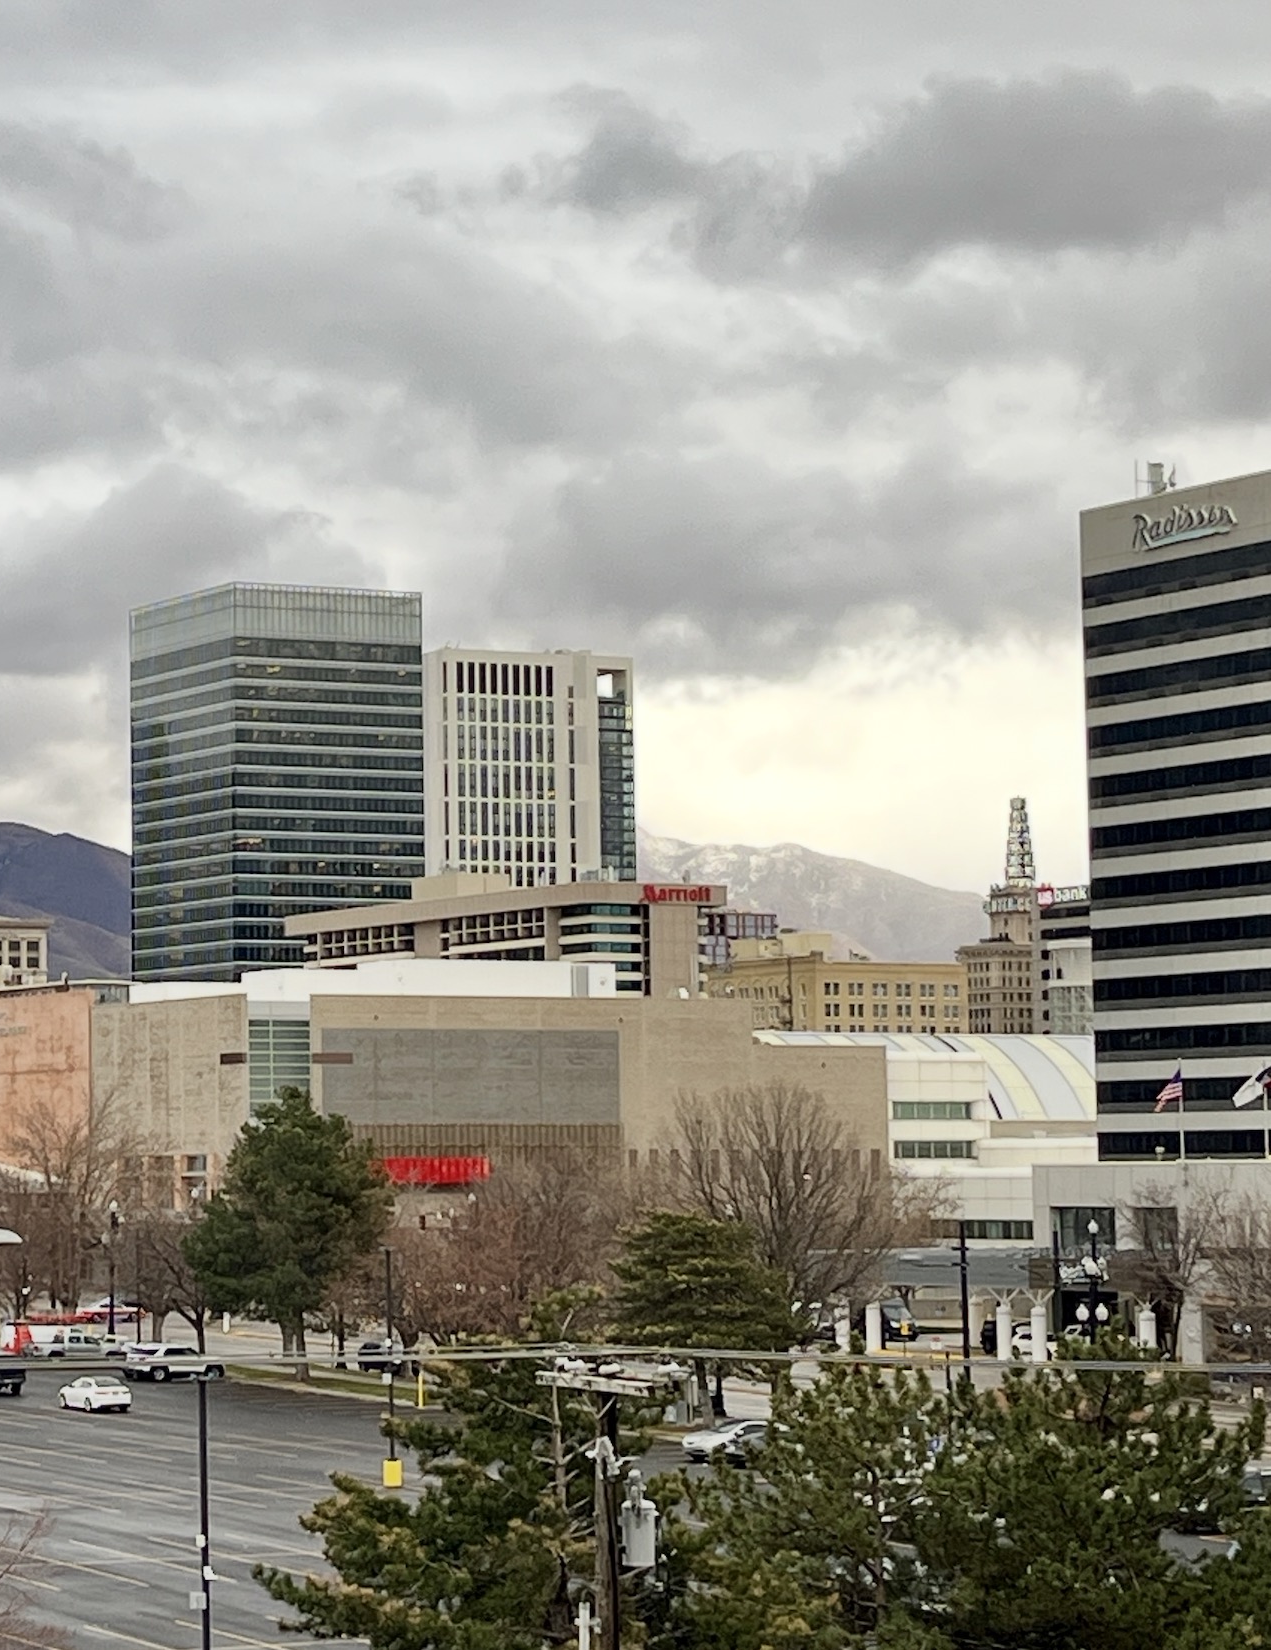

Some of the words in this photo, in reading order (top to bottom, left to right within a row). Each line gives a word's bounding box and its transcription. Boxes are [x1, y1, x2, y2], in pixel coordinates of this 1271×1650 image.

[1132, 504, 1238, 552] Radisson
[640, 884, 711, 903] Marriott
[1053, 886, 1087, 902] bank
